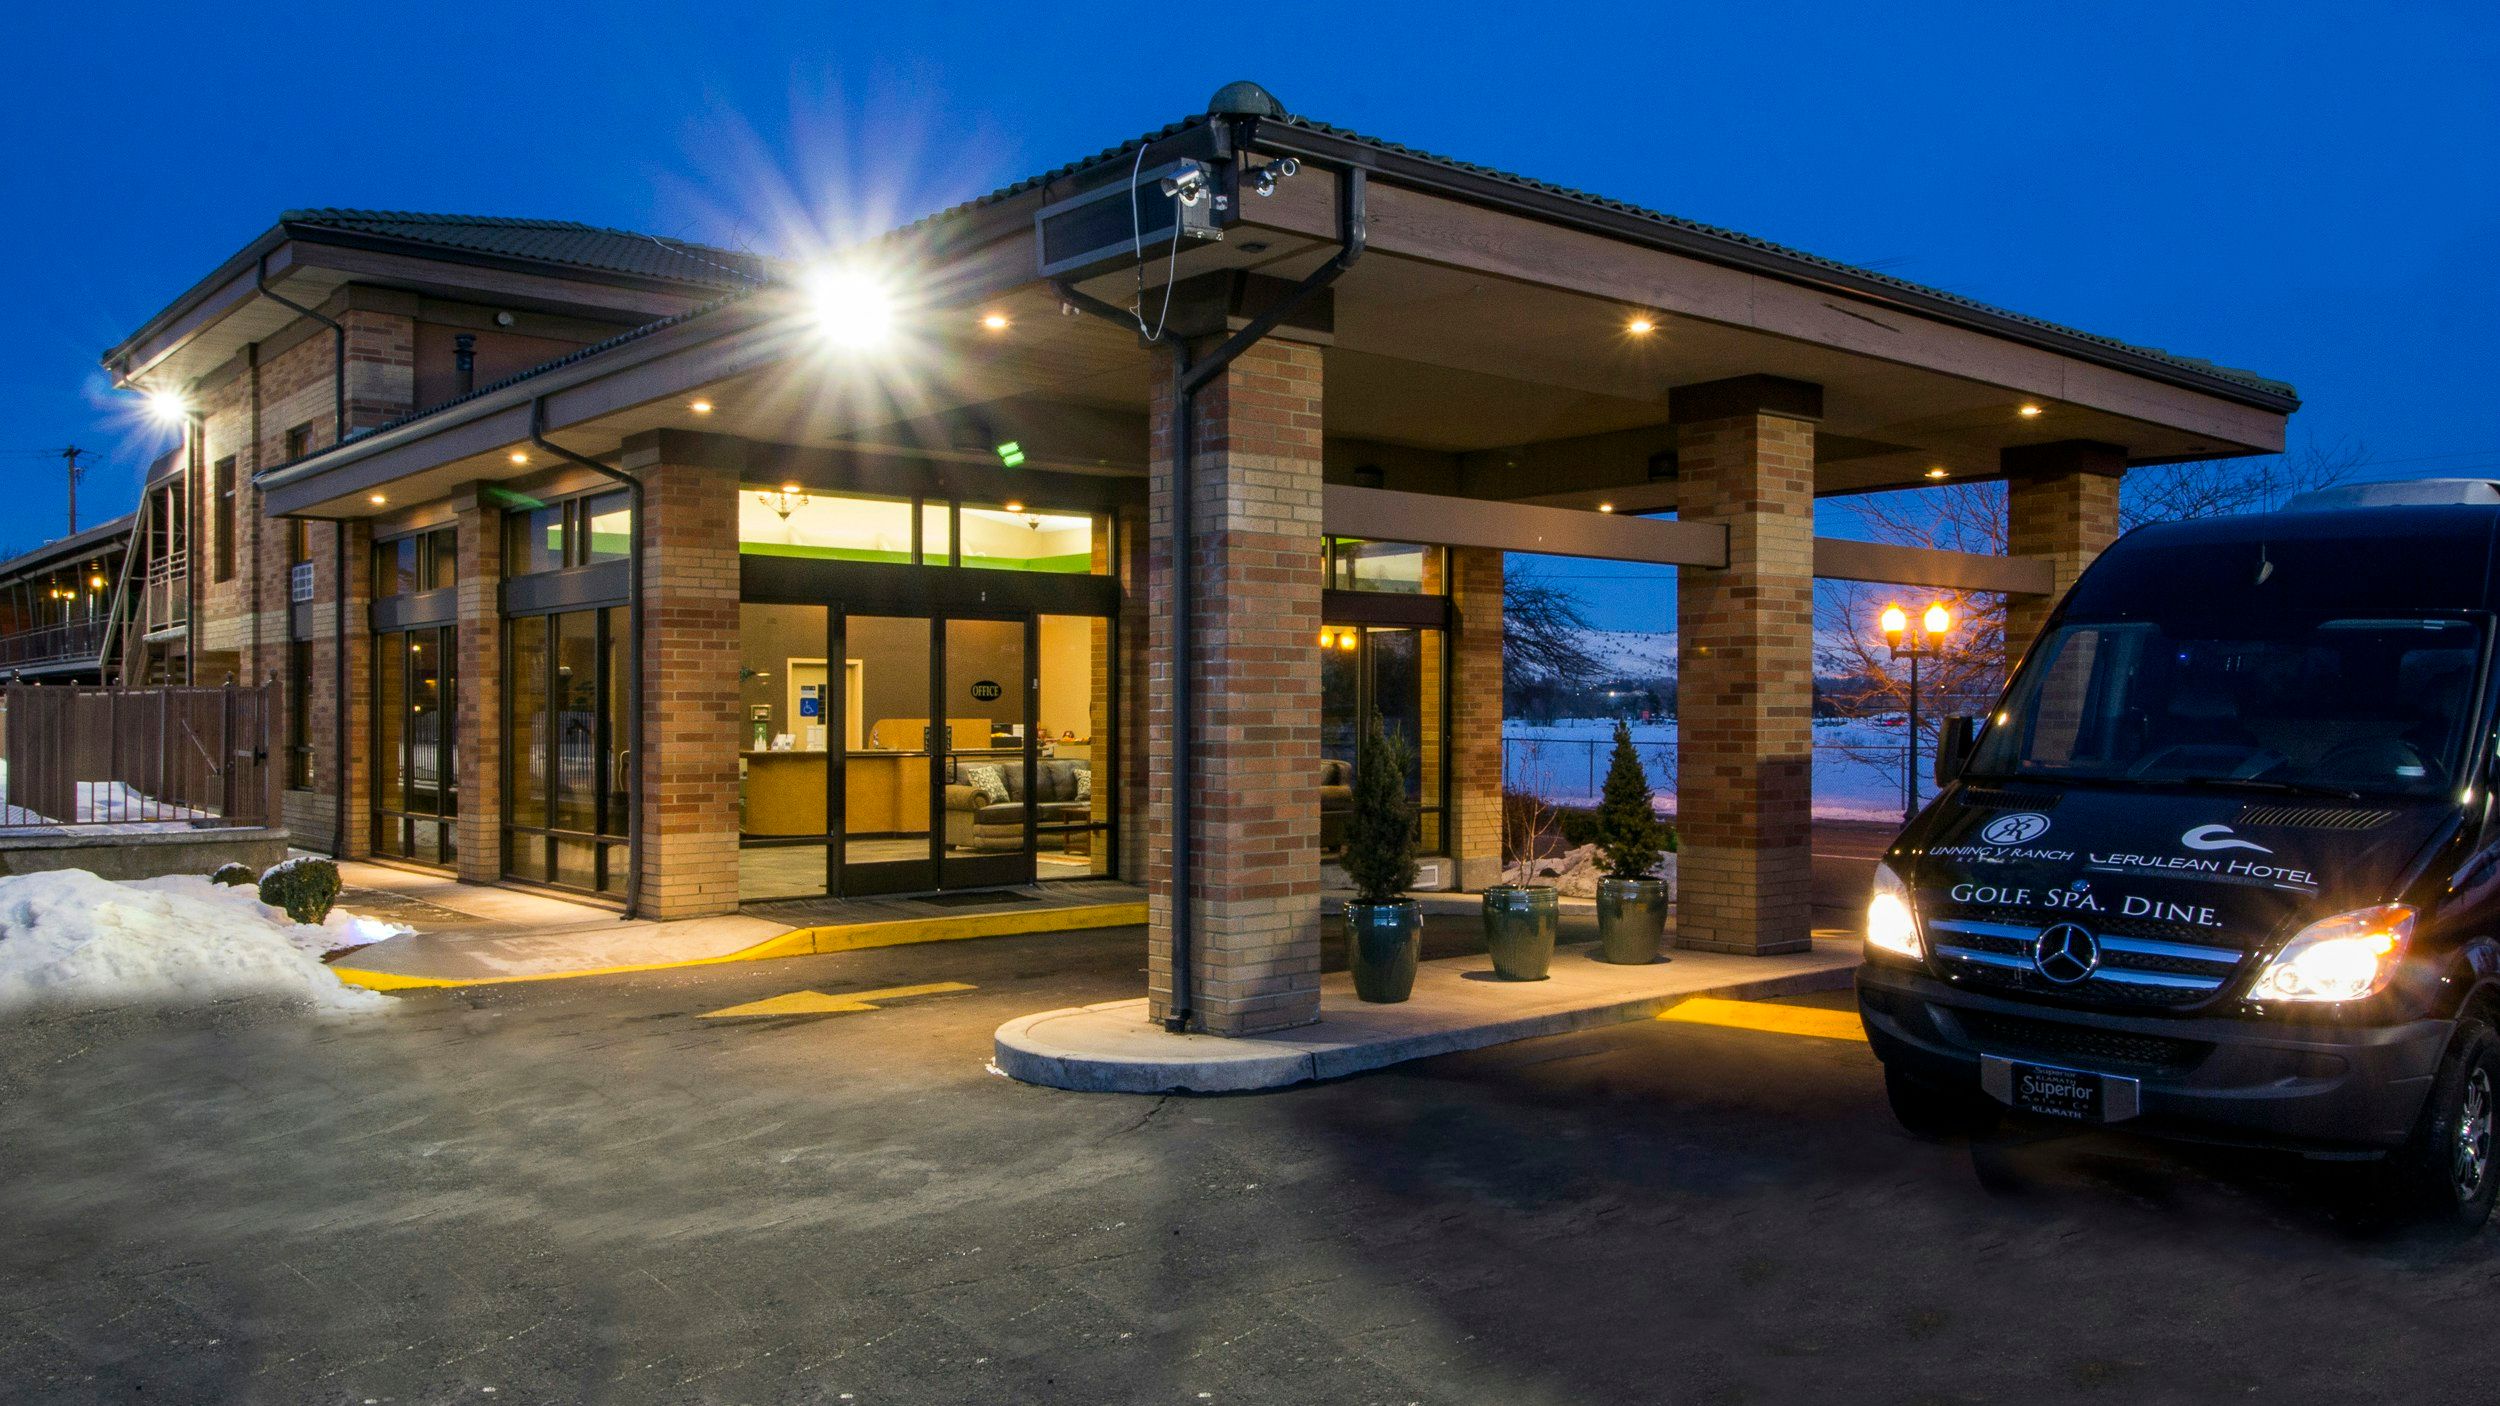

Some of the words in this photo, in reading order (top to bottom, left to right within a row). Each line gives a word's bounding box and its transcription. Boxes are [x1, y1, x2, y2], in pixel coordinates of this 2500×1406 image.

[972, 685, 999, 697] OFFICE
[1996, 847, 2010, 856] Y
[2010, 848, 2075, 861] RANCH
[2227, 860, 2318, 885] HOTEL
[1950, 883, 2031, 905] GOLF.
[2044, 888, 2106, 911] SPA.
[2121, 895, 2223, 927] DINE.
[2021, 1075, 2093, 1100] Superior
[2031, 1105, 2082, 1119] KLAMATH
